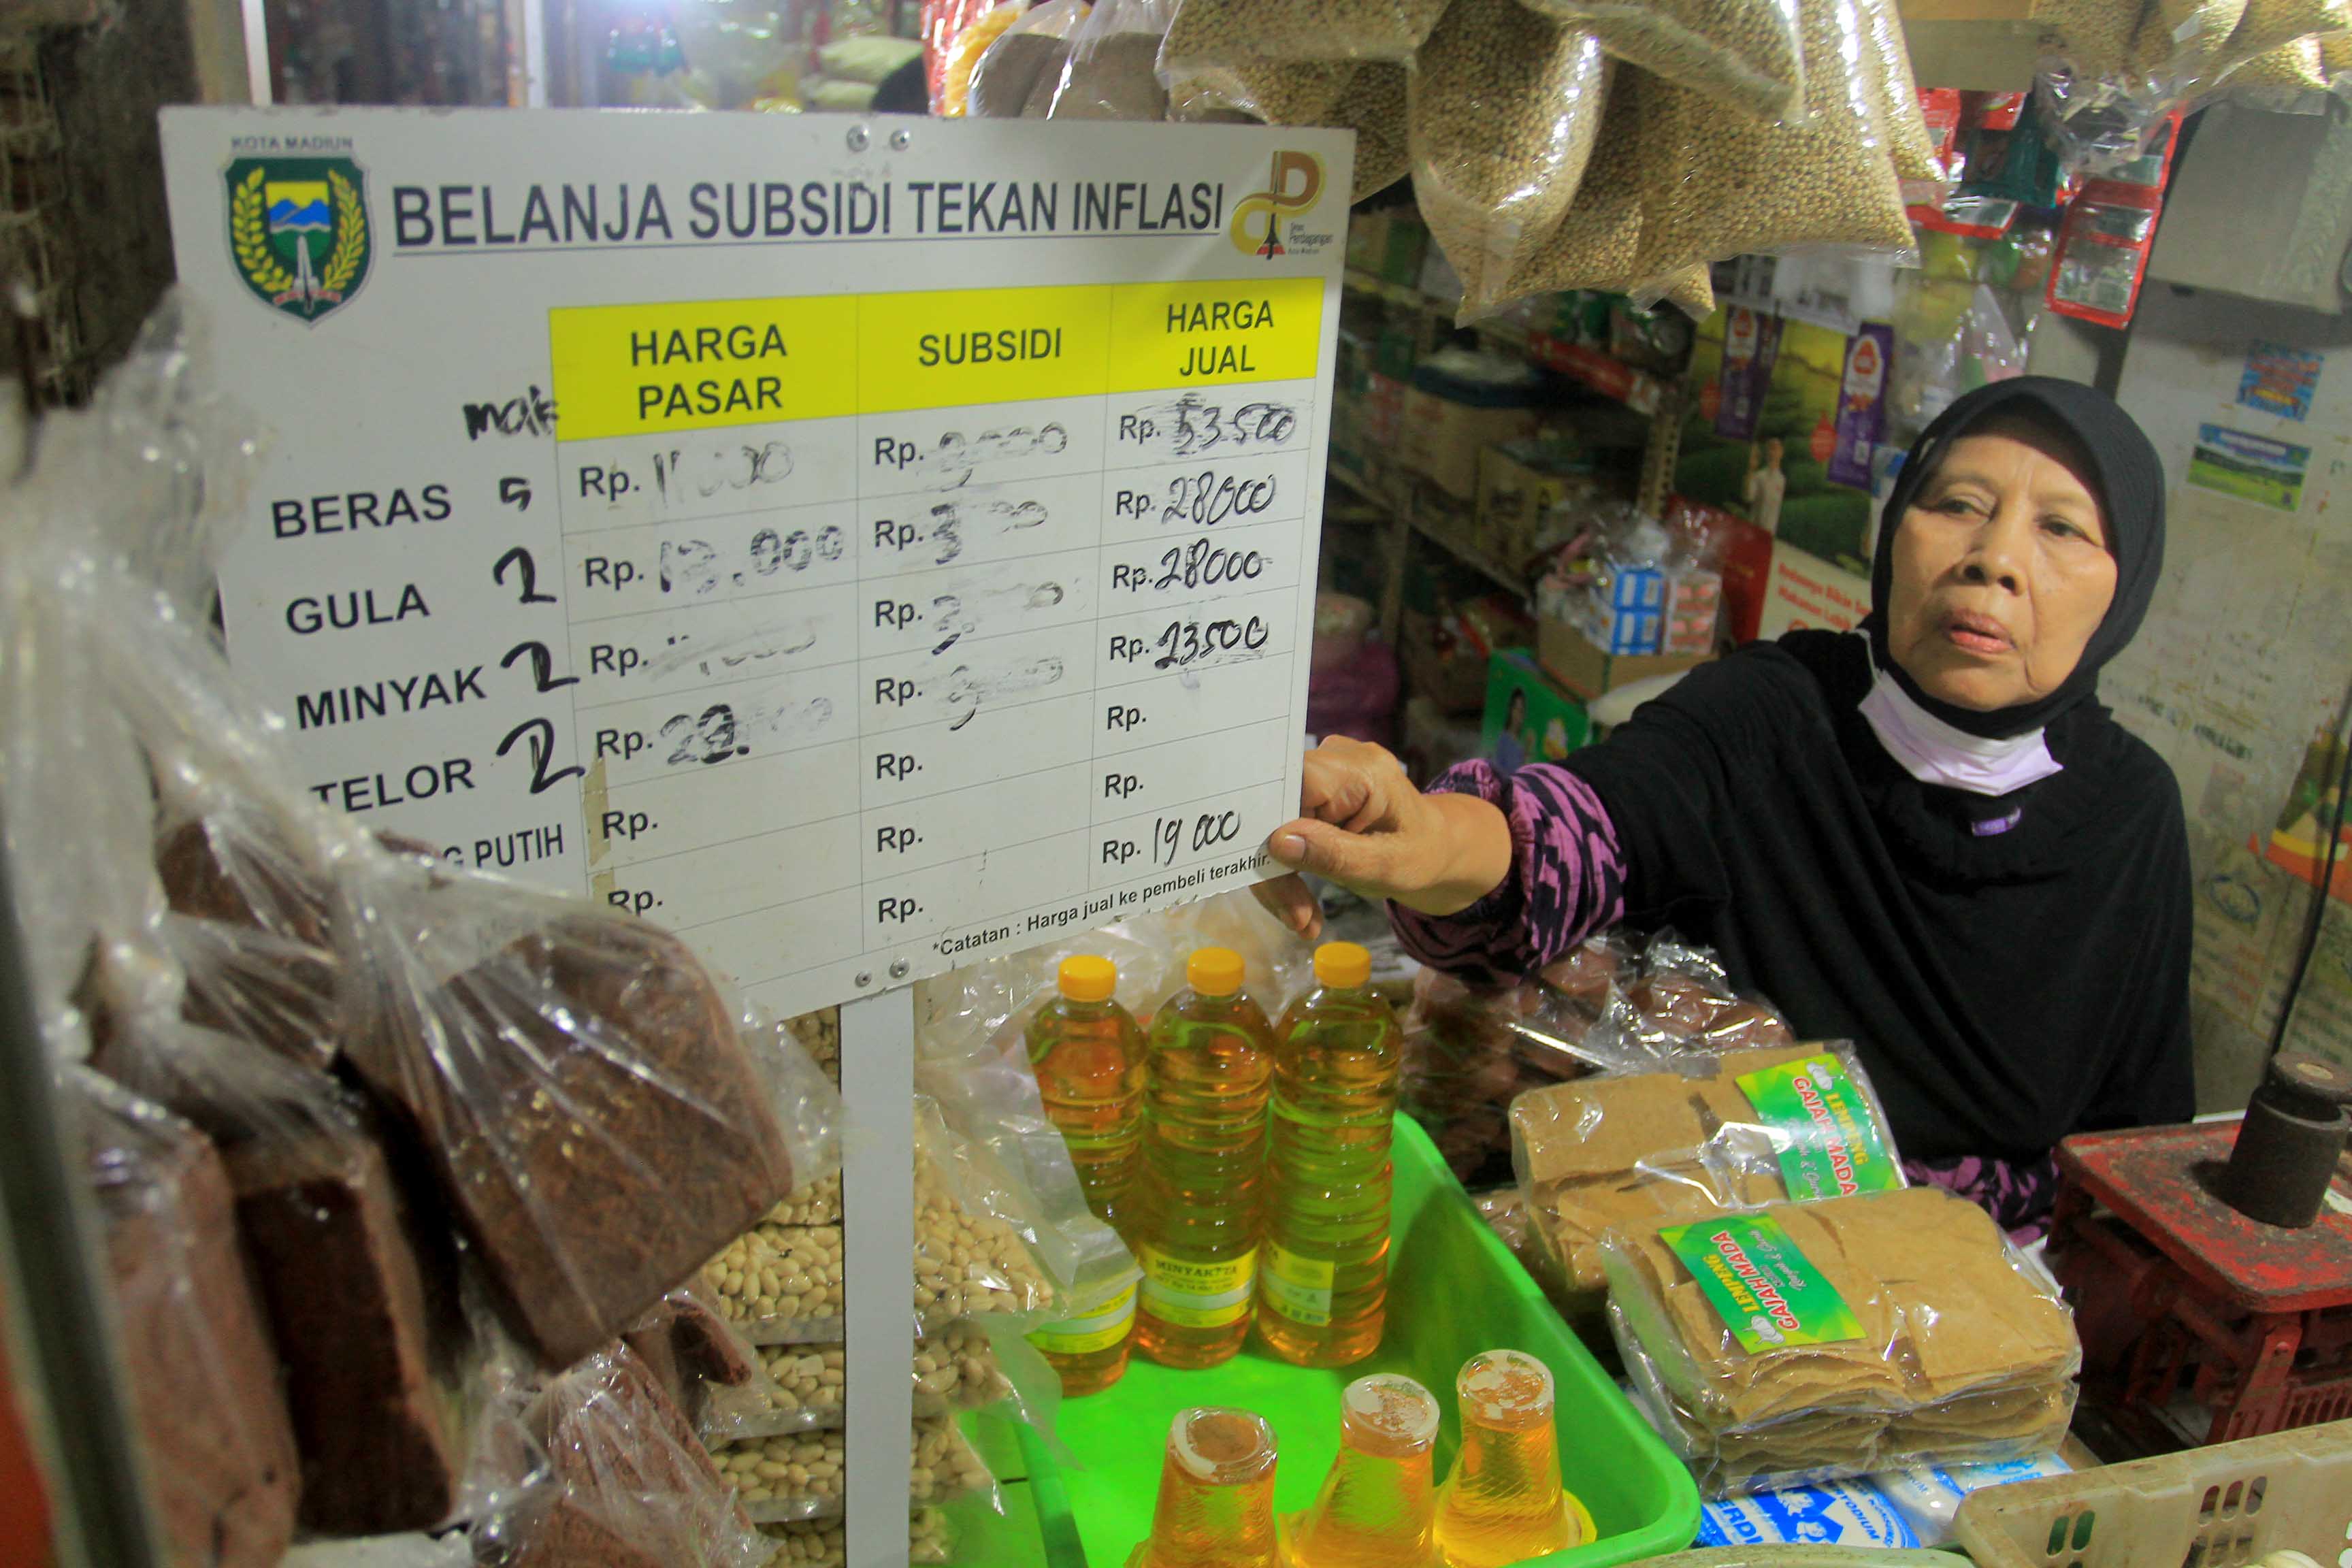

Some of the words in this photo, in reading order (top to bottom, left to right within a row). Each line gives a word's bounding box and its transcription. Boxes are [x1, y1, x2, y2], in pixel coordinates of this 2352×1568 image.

[231, 136, 280, 149] KOTA
[285, 135, 353, 149] MADIUN
[393, 182, 672, 246] BELANJA
[689, 181, 891, 239] SUBSIDI
[908, 182, 1058, 234] TEKAN
[1073, 182, 1223, 231] INFLASI
[1167, 300, 1273, 333] HARGA
[632, 324, 787, 366] HARGA
[919, 327, 1061, 366] SUBSIDI
[1180, 345, 1255, 376] JUAL
[639, 376, 782, 419] PASAR
[1120, 414, 1160, 444] Rp.
[875, 437, 924, 470] Rp.
[580, 466, 639, 502] Rp.
[1162, 471, 1276, 525] 28000
[272, 484, 451, 538] BERAS
[1117, 491, 1156, 519] Rp.
[875, 520, 924, 551] Rp.
[493, 546, 557, 603] 2
[585, 557, 644, 591] Rp.
[1113, 565, 1152, 591] Rp.
[1155, 538, 1262, 589] 28000
[287, 584, 430, 634] GULA
[875, 600, 923, 630] Rp.
[590, 644, 649, 676] Rp.
[1110, 636, 1149, 662] Rp.
[501, 641, 580, 692] 2
[297, 665, 486, 729] MINYAK
[876, 677, 923, 706] Rp.
[1107, 706, 1147, 732] Rp.
[496, 717, 585, 794] 2
[596, 728, 653, 759] Rp.
[877, 753, 922, 781] Rp.
[311, 758, 475, 813] TELOR
[1105, 773, 1144, 798] Rp.
[602, 811, 658, 840] Rp.
[877, 827, 923, 853] Rp.
[475, 823, 564, 868] PUTIH
[1102, 840, 1141, 864] Rp.
[608, 889, 663, 916] Rp.
[1028, 906, 1078, 931] Harga
[1083, 895, 1113, 921] jual
[1119, 891, 1137, 906] ke
[1143, 869, 1205, 902] pembeli
[1210, 853, 1270, 881] terakhir.
[879, 898, 924, 923] Rp.
[1793, 1077, 1836, 1135] GAJAH
[1824, 1136, 1858, 1196] MADA
[1825, 1092, 1869, 1166] LEMPENG
[1710, 1230, 1760, 1278] MADA
[1702, 1254, 1761, 1313] LEMPENG
[1746, 1277, 1800, 1330] GAJAH
